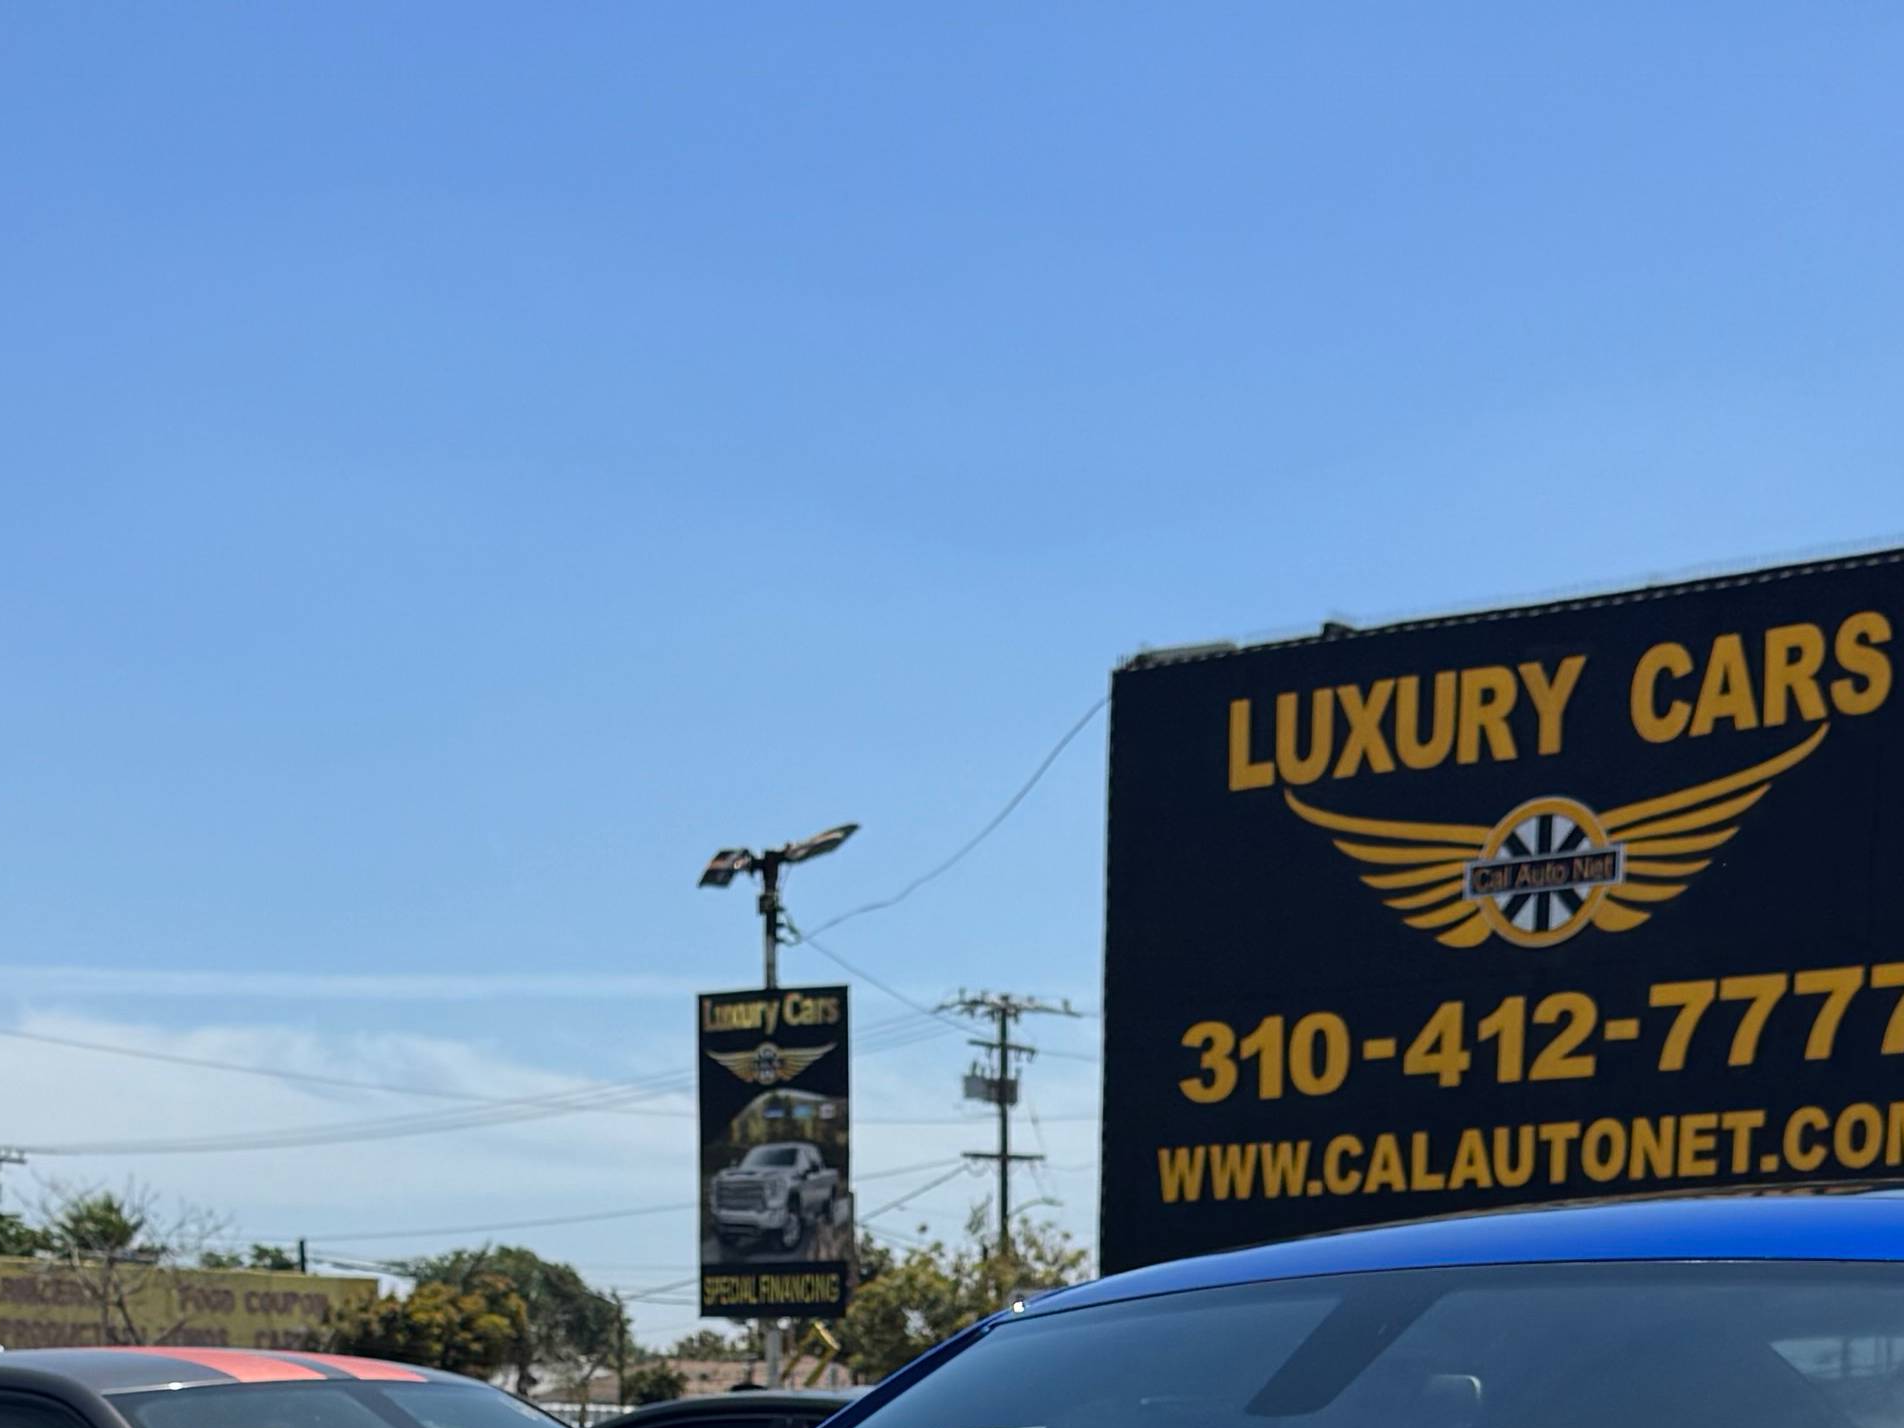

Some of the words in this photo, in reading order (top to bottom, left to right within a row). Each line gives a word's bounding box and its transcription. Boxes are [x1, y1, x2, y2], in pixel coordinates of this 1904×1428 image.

[1228, 653, 1586, 792] LUXURY
[1630, 610, 1893, 746] CARS
[1472, 865, 1510, 894] Cal
[1515, 859, 1570, 887] Auto
[1573, 855, 1615, 881] Net
[703, 999, 779, 1036] Luxury
[782, 992, 840, 1027] Cars
[703, 1274, 758, 1306] SPECIAL
[758, 1272, 841, 1304] FINANCING
